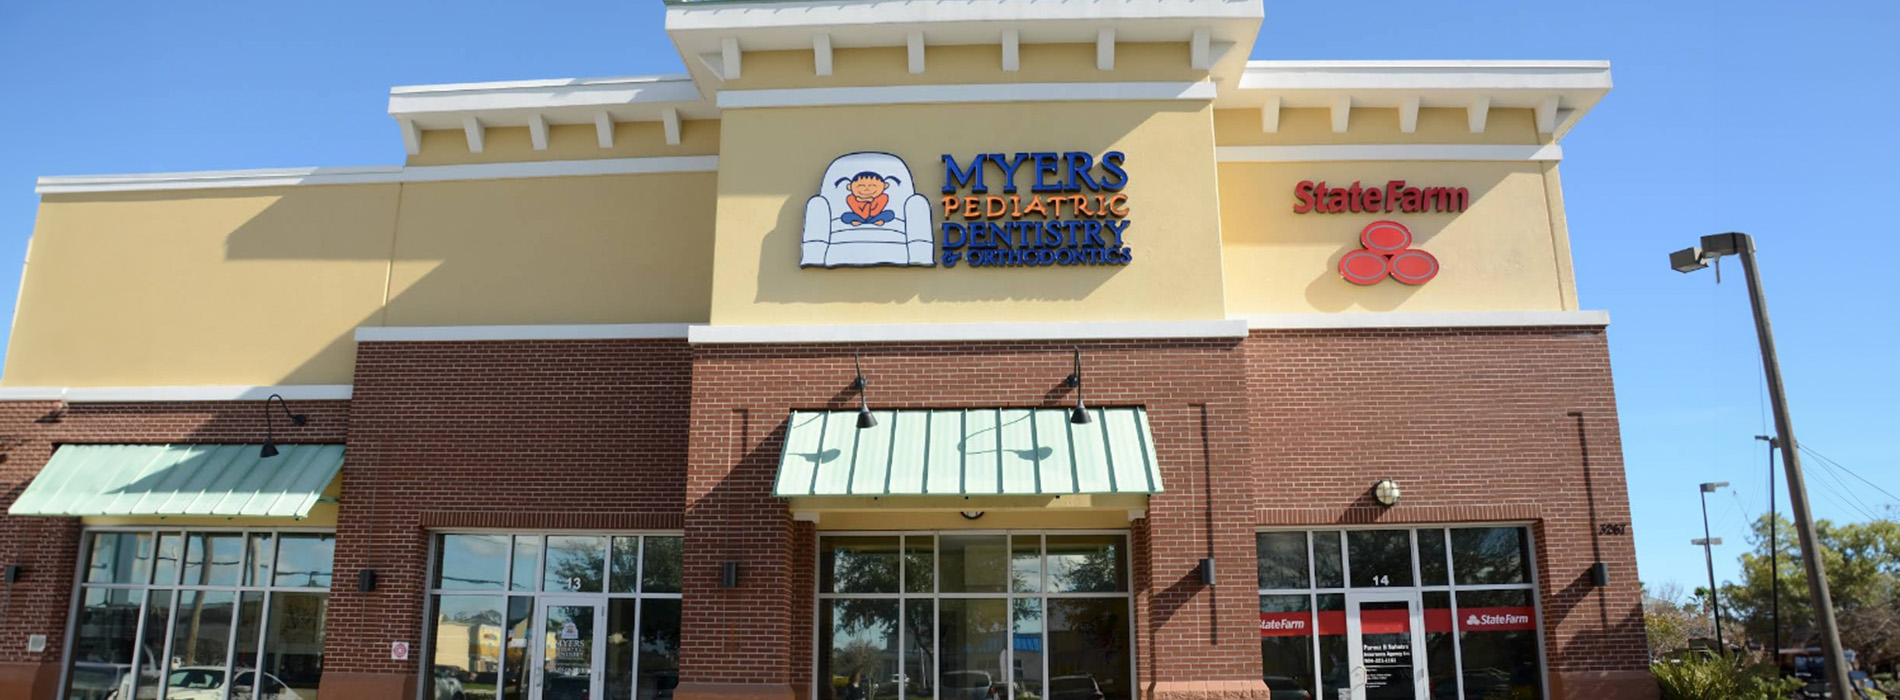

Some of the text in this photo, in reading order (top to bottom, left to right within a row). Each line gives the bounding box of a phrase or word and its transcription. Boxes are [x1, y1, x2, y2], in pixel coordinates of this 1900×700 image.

[941, 151, 1129, 194] MYERS
[941, 193, 1131, 220] PEDIATRIC
[941, 219, 1132, 251] DENTISTRY
[941, 247, 1133, 268] & ORTHODONTICS
[1599, 523, 1627, 536] 3267
[566, 577, 582, 590] 13
[1372, 575, 1390, 586] 14
